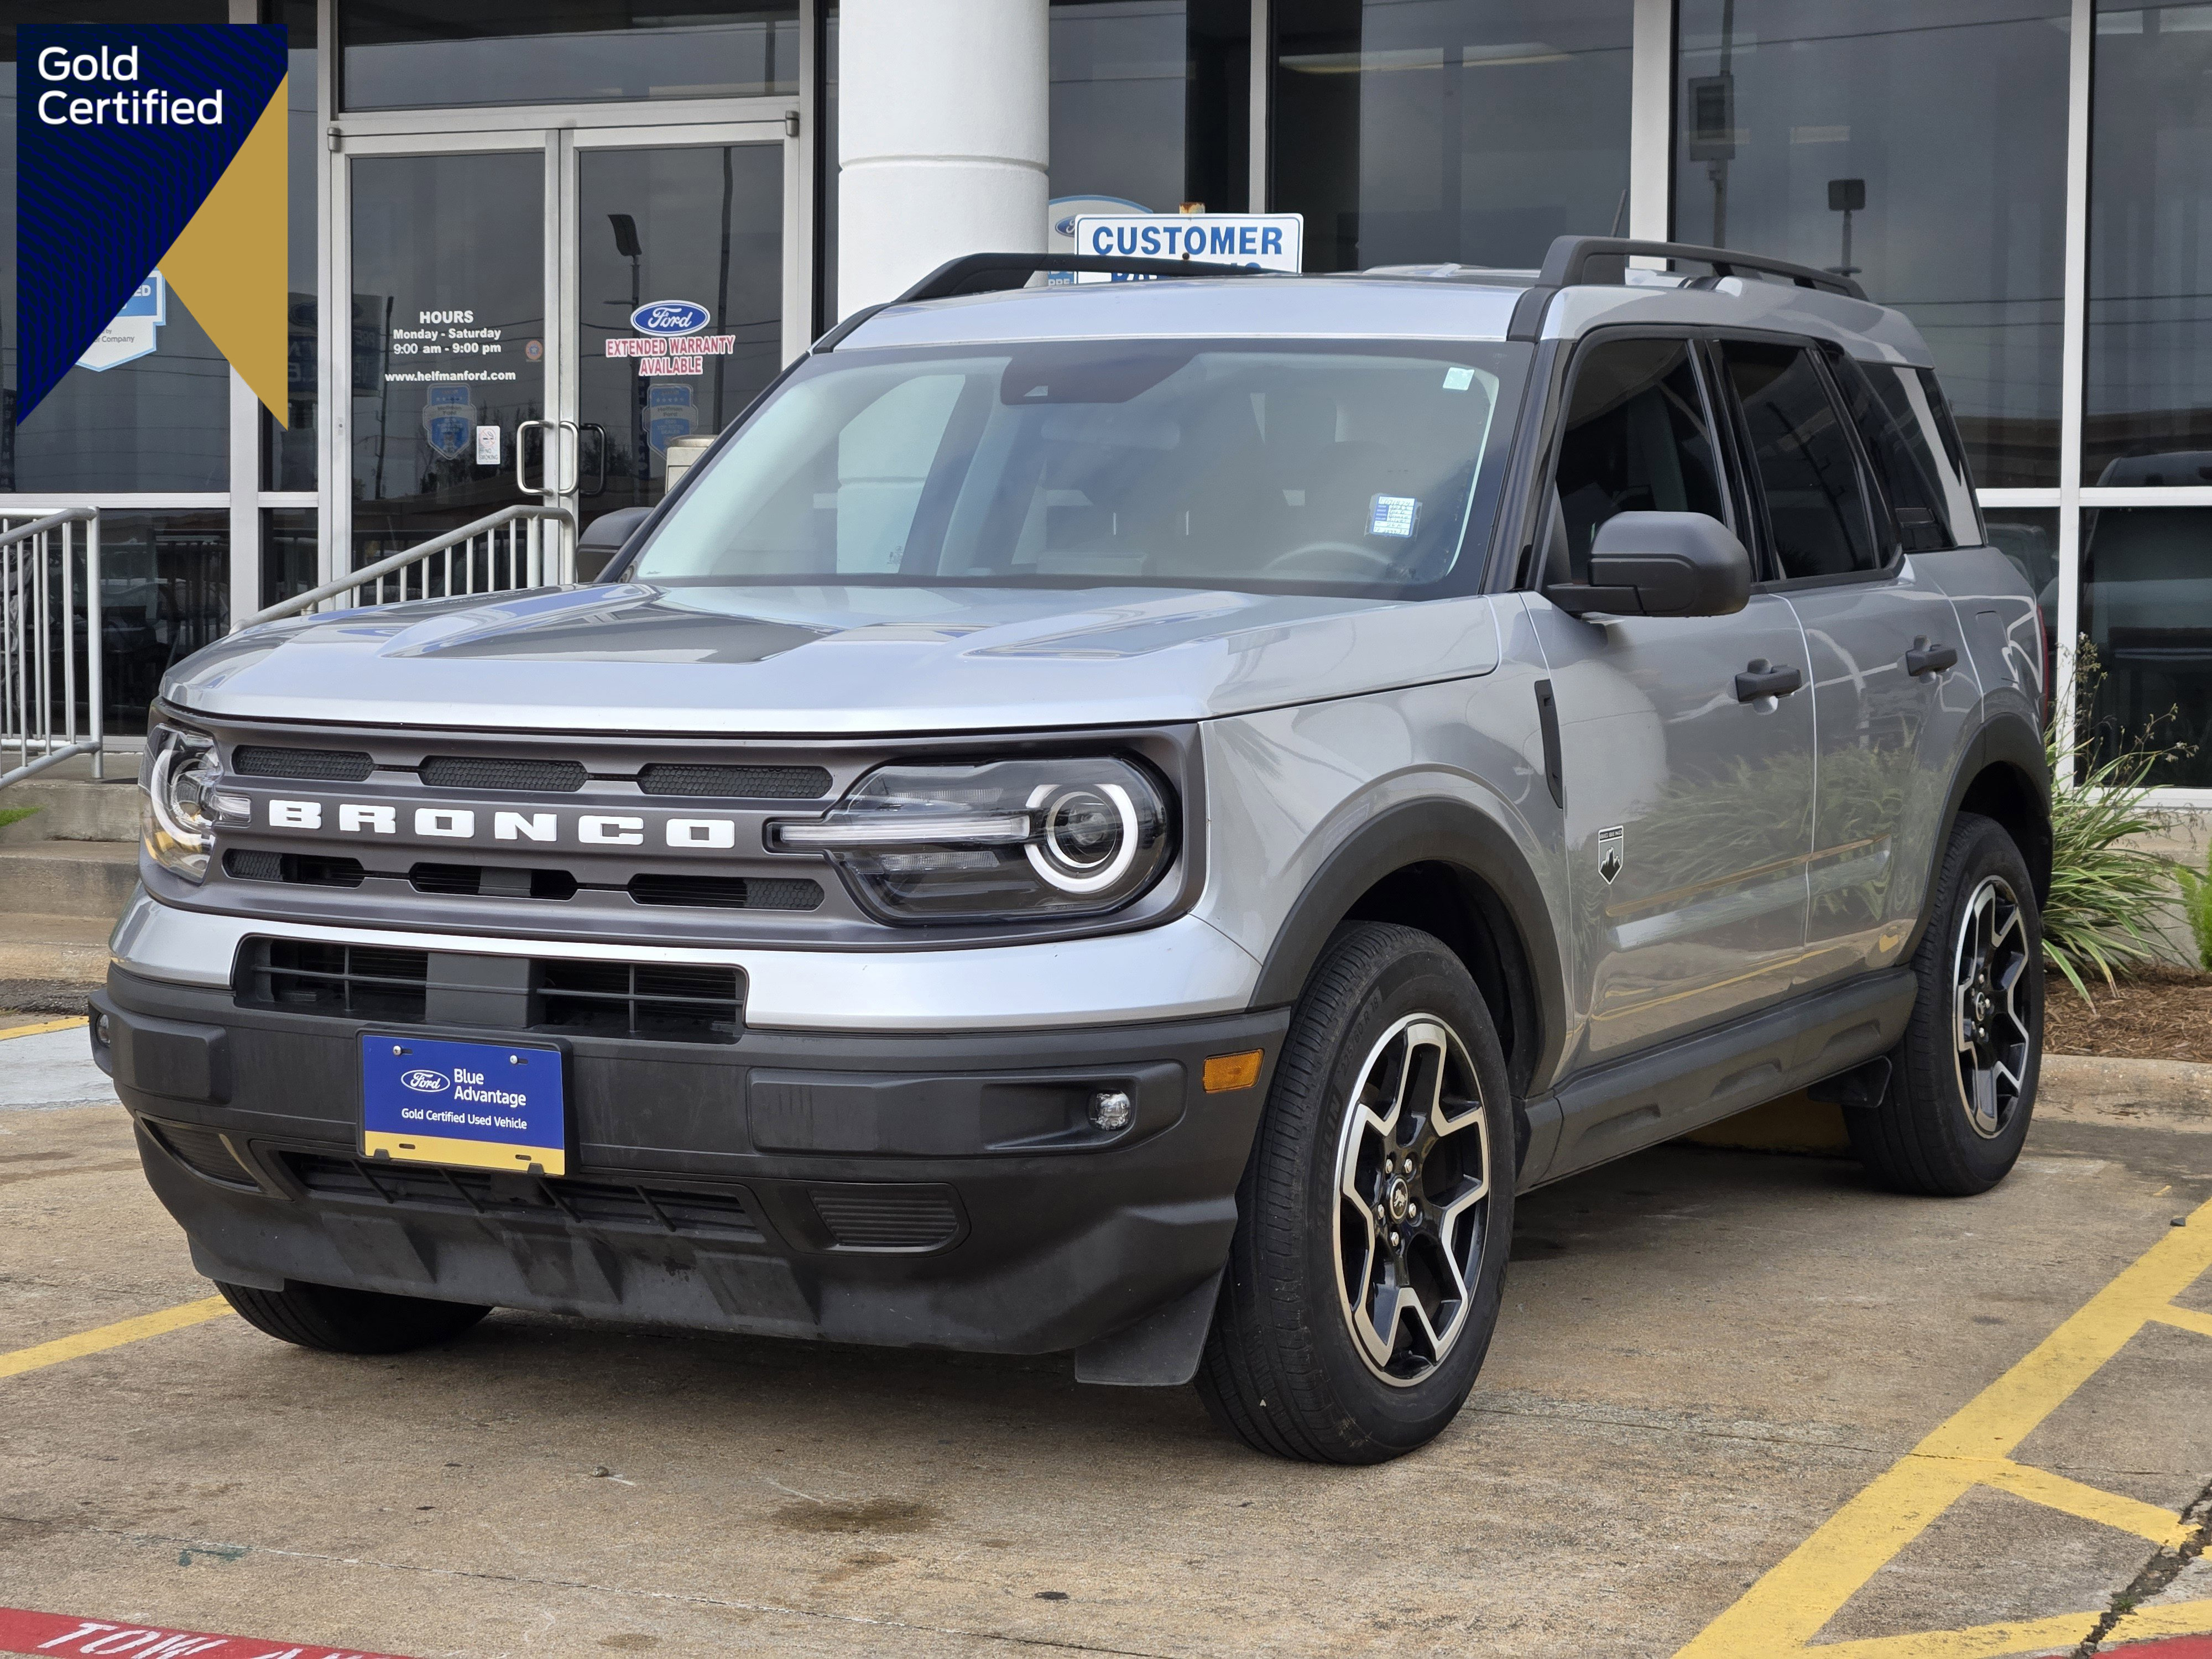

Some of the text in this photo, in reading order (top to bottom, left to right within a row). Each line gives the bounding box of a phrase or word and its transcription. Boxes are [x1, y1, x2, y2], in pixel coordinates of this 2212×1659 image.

[1092, 226, 1282, 255] CUSTOMER
[420, 311, 473, 324] HOURS
[648, 307, 693, 327] Ford
[393, 329, 438, 341] Monday
[448, 328, 501, 340] Saturday
[393, 343, 418, 354] 9:00
[452, 343, 479, 353] 9:00
[482, 344, 502, 354] pm
[607, 336, 735, 357] EXTENDED WARRANTY
[639, 357, 703, 375] AVAILABLE
[385, 371, 516, 381] www.helfmanford.com
[269, 799, 735, 848] BRONCO
[410, 1072, 441, 1089] Ford
[454, 1068, 484, 1085] Blue
[454, 1086, 526, 1108] Advantage
[401, 1108, 527, 1129] Gold Certified Used Vehicle
[36, 1623, 228, 1659] TOW
